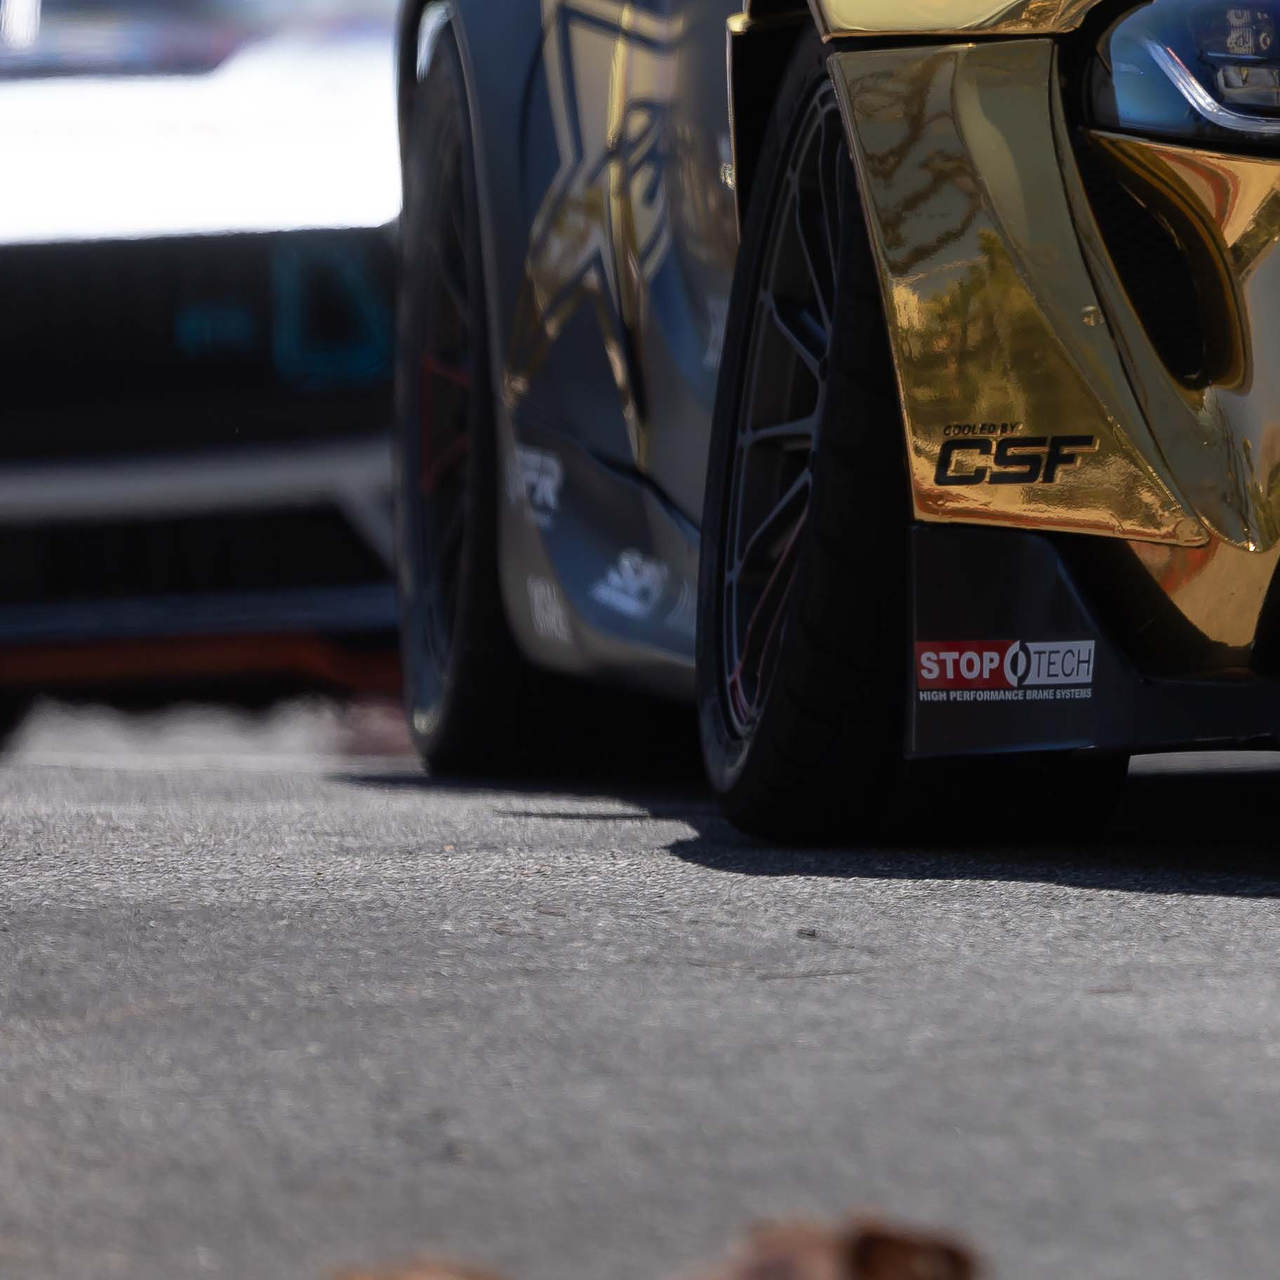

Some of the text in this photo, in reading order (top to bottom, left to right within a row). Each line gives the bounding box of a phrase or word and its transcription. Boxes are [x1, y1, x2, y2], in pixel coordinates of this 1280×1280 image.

[943, 422, 1020, 437] COOLED BY
[934, 435, 1094, 486] CSF
[919, 687, 1093, 702] HIGH PERFORMANCE BRAKE SYSTEMS
